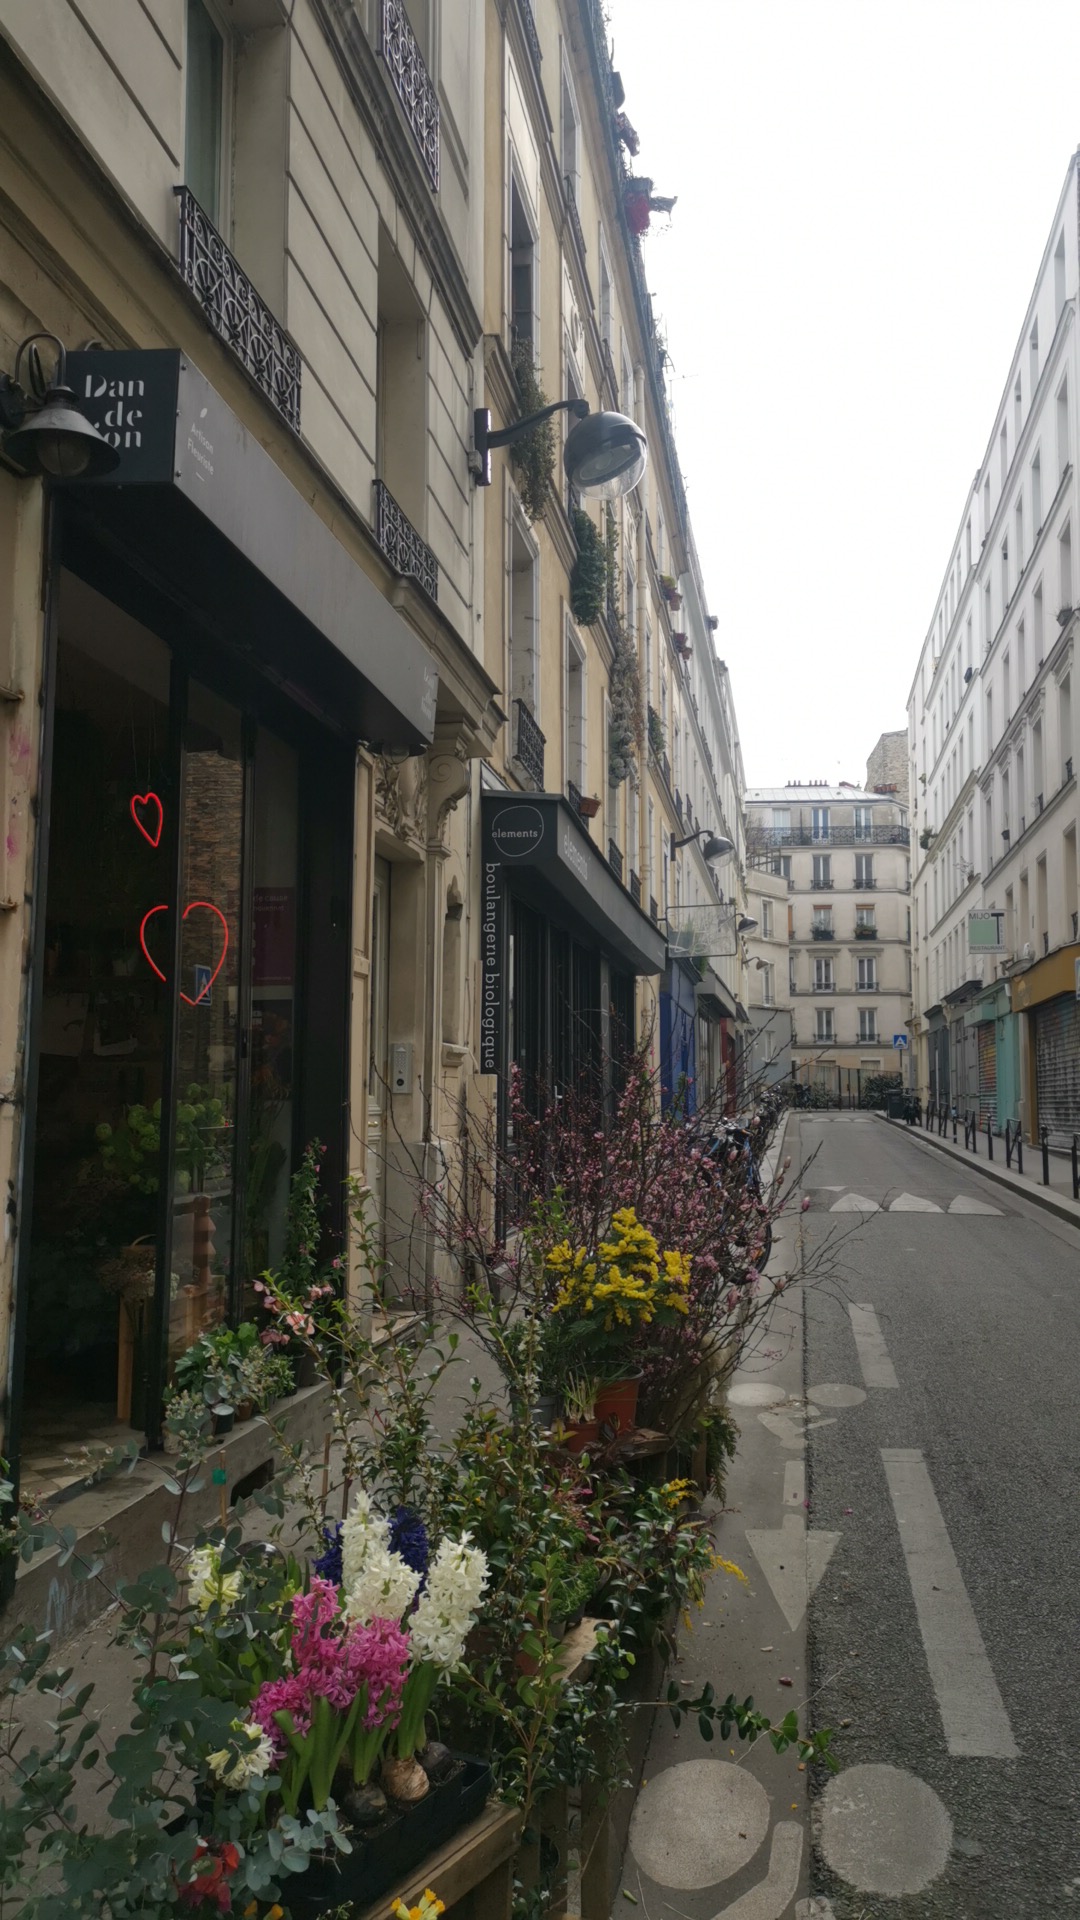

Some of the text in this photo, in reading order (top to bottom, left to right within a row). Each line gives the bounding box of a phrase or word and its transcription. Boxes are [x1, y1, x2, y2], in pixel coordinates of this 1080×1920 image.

[85, 374, 144, 398] Dan
[104, 401, 143, 427] de
[491, 828, 538, 839] elements
[481, 862, 501, 1068] boulangerie biologique
